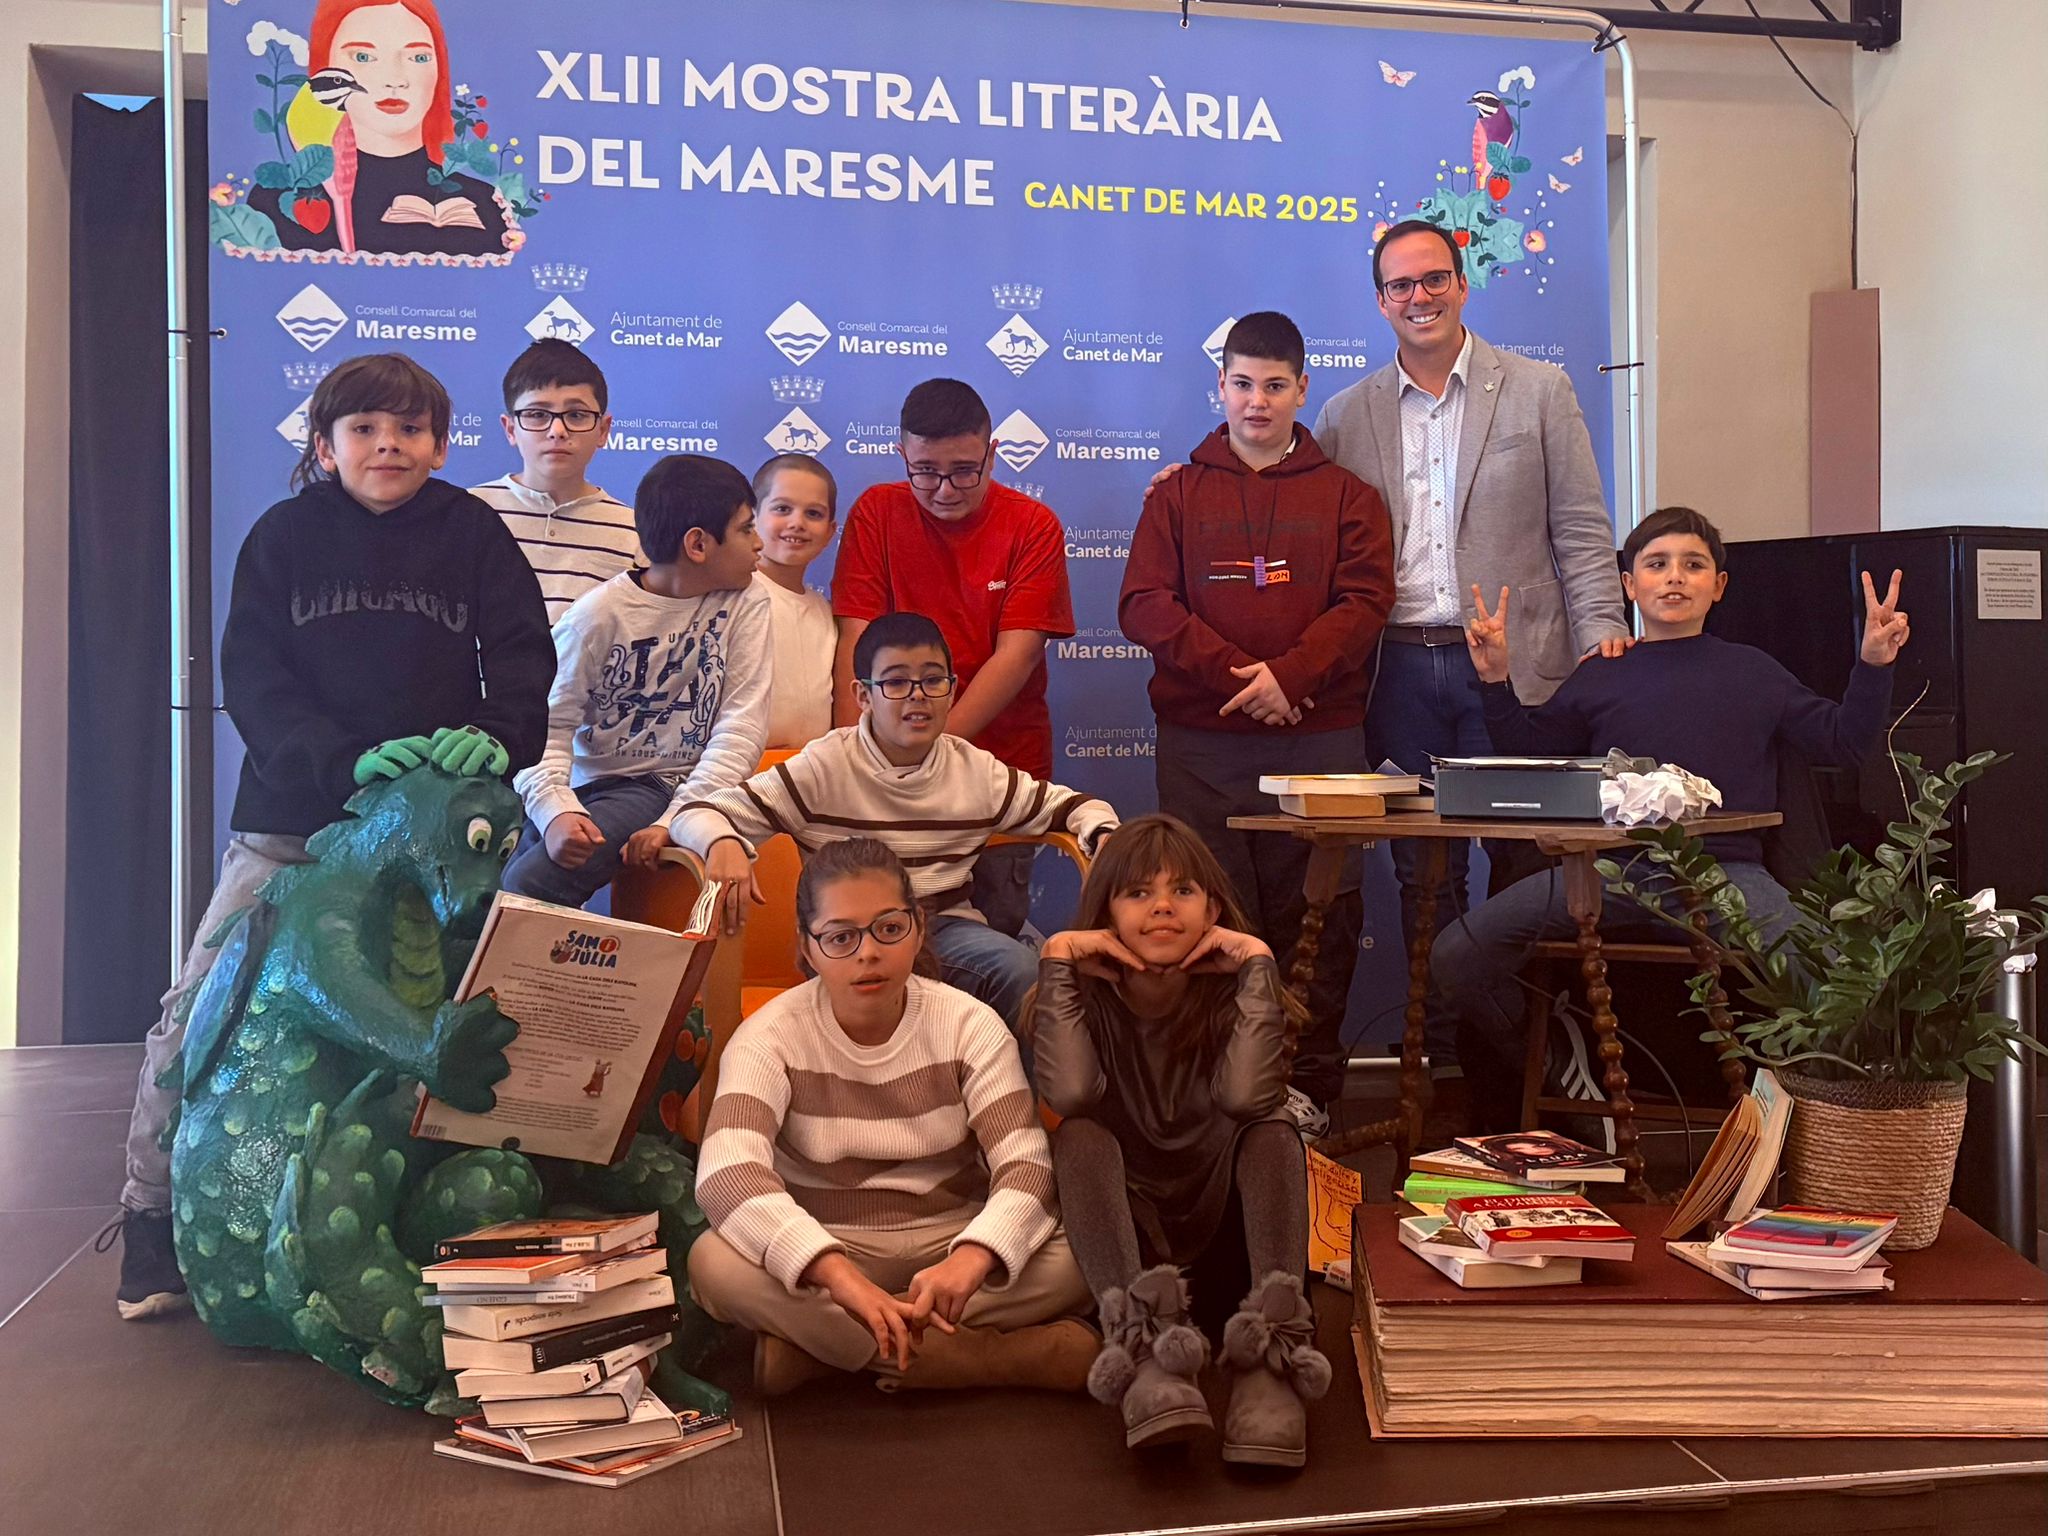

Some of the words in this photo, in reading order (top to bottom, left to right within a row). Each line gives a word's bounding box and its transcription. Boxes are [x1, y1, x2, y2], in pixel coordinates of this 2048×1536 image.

[535, 49, 660, 108] XLII
[683, 60, 961, 124] MOSTRA
[977, 75, 1283, 143] LITERÀRIA
[537, 135, 660, 190] DEL
[681, 143, 994, 207] MARESME
[1023, 181, 1136, 212] CANET
[1144, 188, 1187, 215] DE
[1195, 190, 1268, 219] MAR
[1275, 194, 1358, 223] 2025
[355, 304, 399, 316] Consell
[401, 306, 456, 318] Comarcal
[459, 308, 478, 319] del
[610, 311, 701, 329] Ajuntament
[703, 314, 723, 329] de
[356, 319, 478, 342] Maresme
[837, 321, 877, 332] Consell
[879, 322, 930, 334] Comarcal
[932, 324, 949, 335] del
[1062, 328, 1144, 345] Ajuntament
[1146, 331, 1164, 345] de
[610, 329, 664, 346] Canet
[665, 333, 685, 346] de
[686, 331, 723, 348] Mar
[838, 335, 949, 356] Maresme
[1304, 336, 1350, 347] Comarcal
[1351, 337, 1367, 348] del
[1063, 345, 1111, 361] Canet
[1112, 349, 1129, 362] de
[1131, 347, 1163, 363] Mar
[1548, 343, 1565, 356] de
[462, 412, 483, 427] de
[611, 418, 642, 429] onsell
[645, 418, 699, 430] Comarcal
[701, 420, 719, 430] del
[602, 432, 719, 452] Maresme
[1055, 428, 1093, 438] Consell
[1095, 429, 1142, 440] Comarcal
[1145, 430, 1161, 440] del
[845, 438, 896, 455] Canet
[1056, 441, 1161, 461] Maresme
[1064, 543, 1111, 558] Canet
[1113, 546, 1130, 558] de
[1057, 641, 1153, 660] Maresm
[1065, 726, 1147, 742] Ajuntament
[1148, 725, 1158, 738] d
[1065, 743, 1113, 758] Canet
[1114, 744, 1132, 757] de
[1133, 742, 1156, 757] Ma
[566, 930, 600, 950] SAM
[569, 948, 617, 969] JÚLIA
